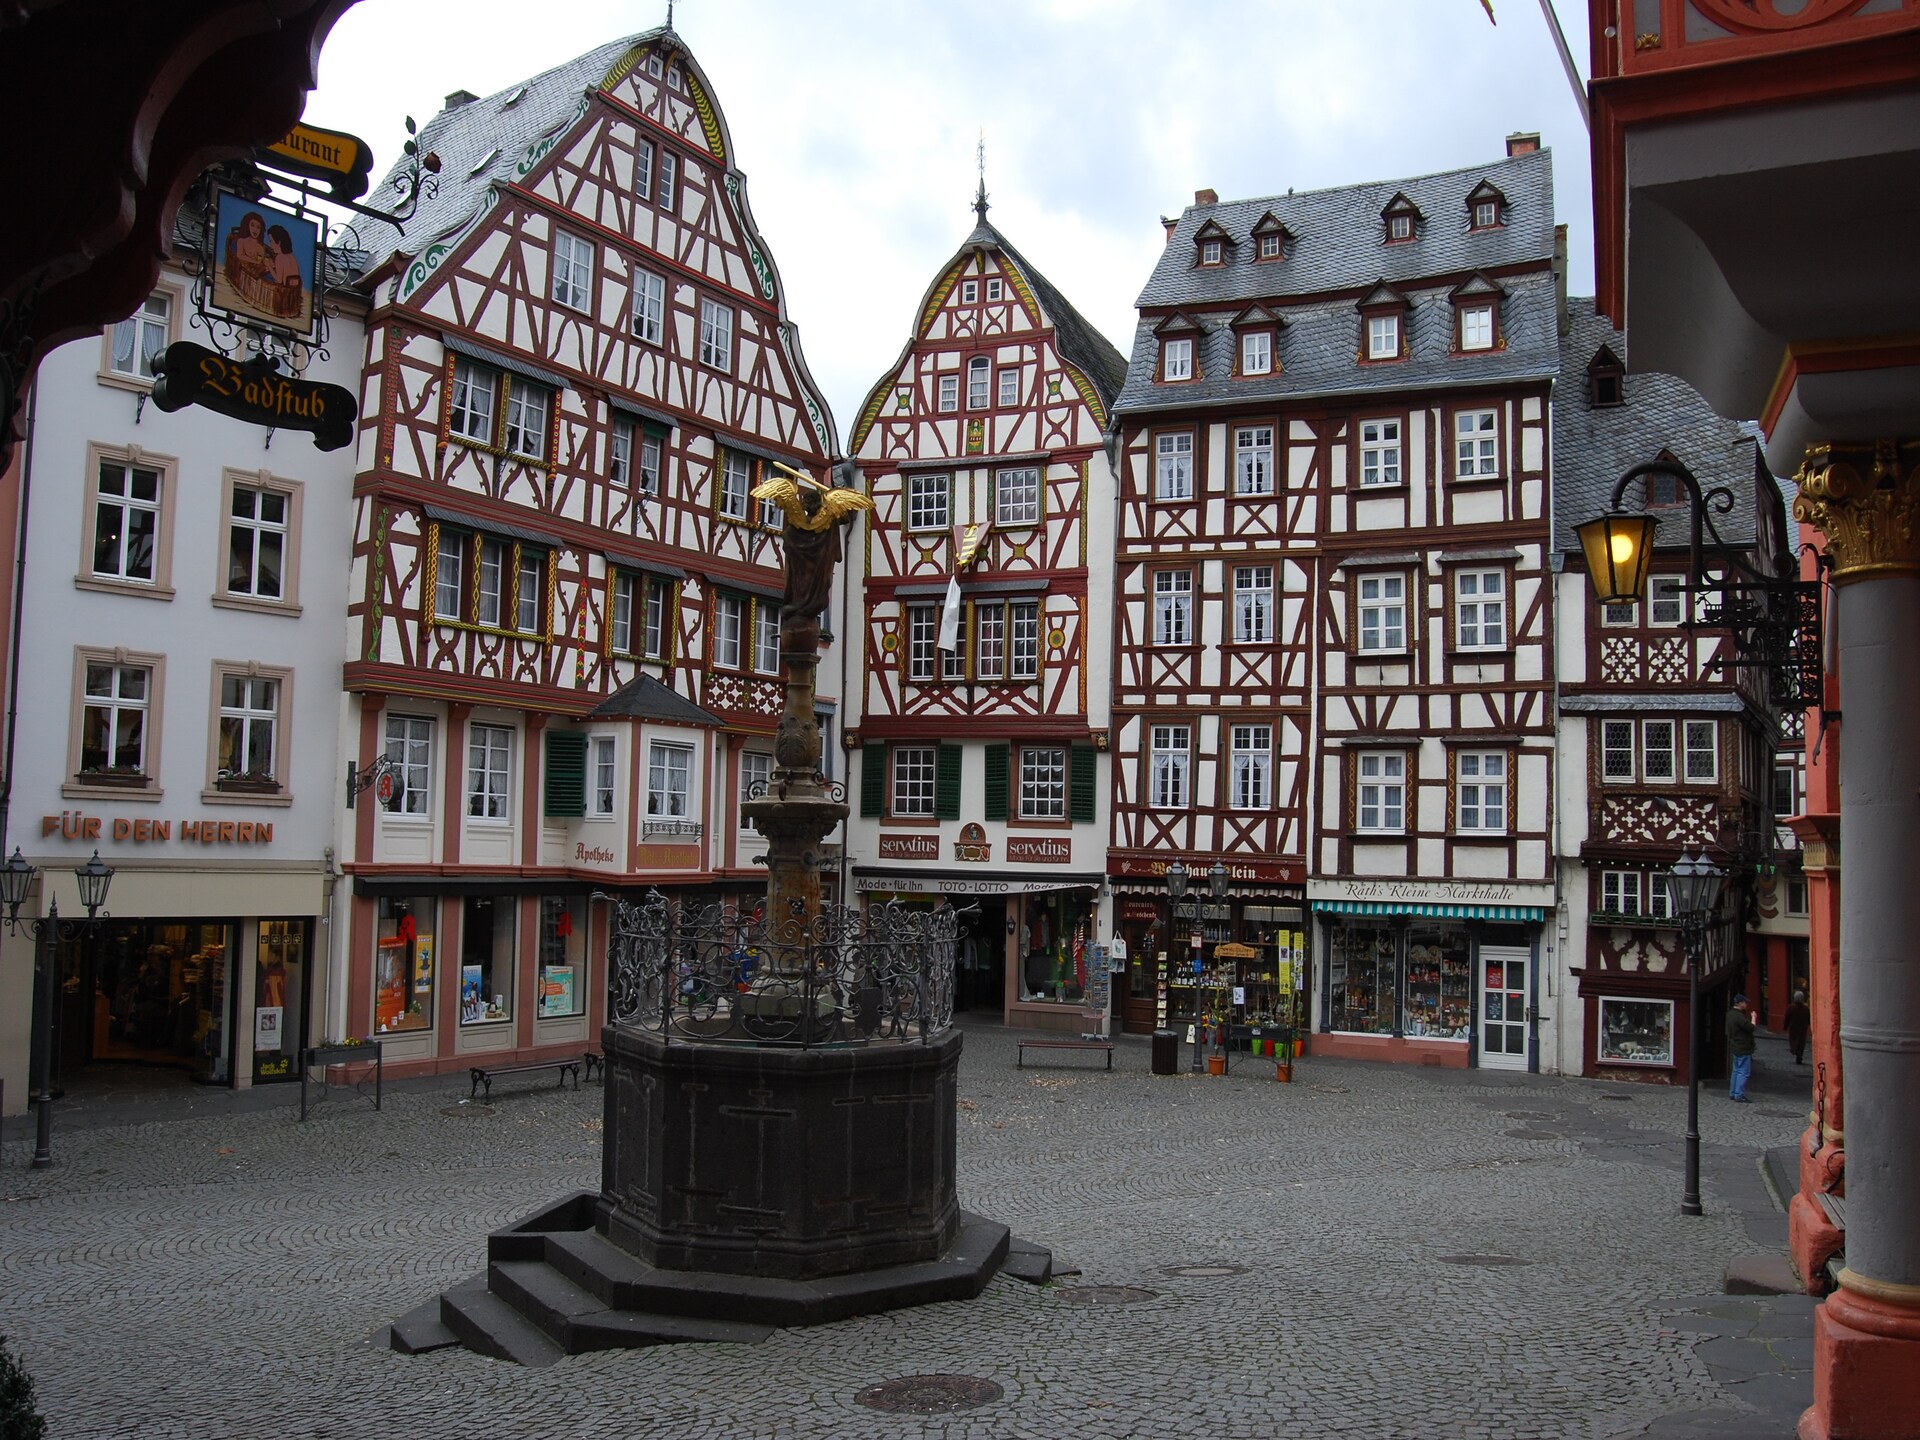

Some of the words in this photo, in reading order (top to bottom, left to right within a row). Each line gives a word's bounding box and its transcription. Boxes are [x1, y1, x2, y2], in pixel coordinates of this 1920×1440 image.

[42, 810, 102, 840] FÜR
[113, 818, 171, 841] DEN
[182, 820, 274, 843] HERRN
[881, 836, 937, 852] servatius
[1009, 839, 1069, 855] servatius
[575, 842, 614, 865] Apotheke
[857, 879, 887, 890] Mode
[893, 879, 907, 891] für
[908, 880, 923, 892] Ihn
[1390, 884, 1431, 900] Kleine
[1435, 886, 1514, 900] Markthalle
